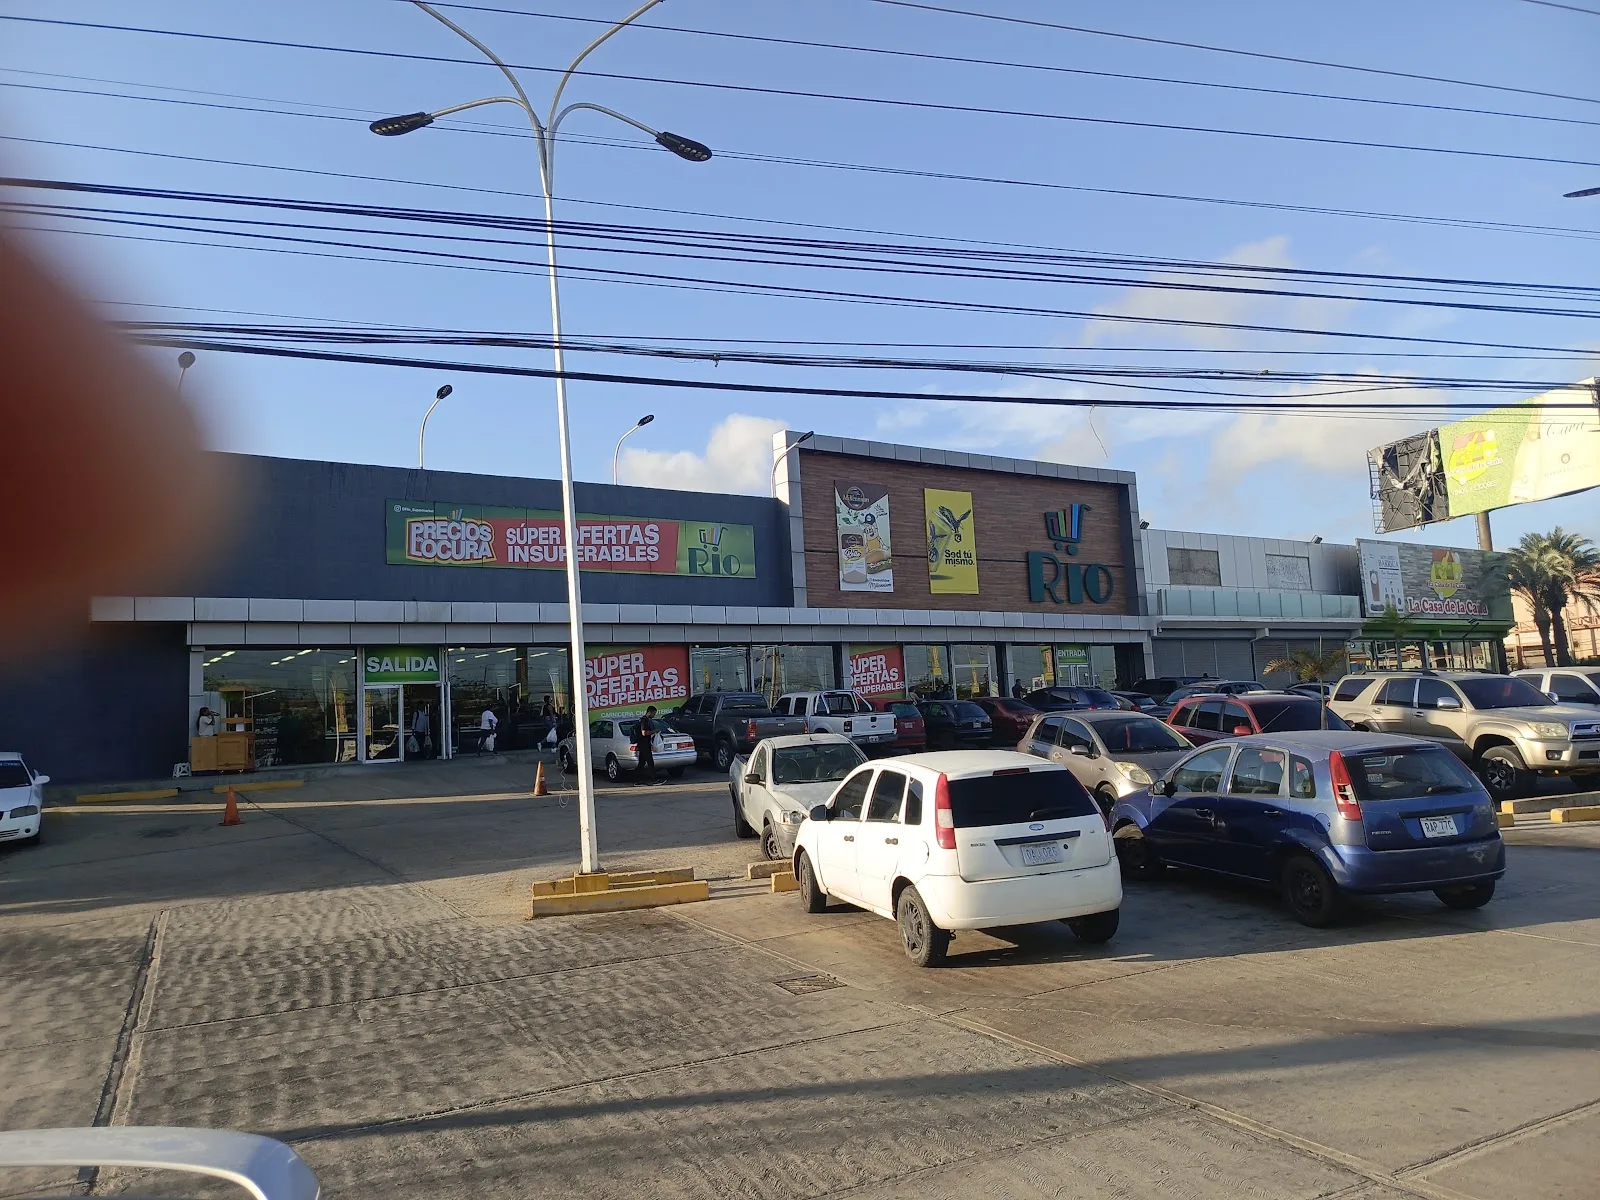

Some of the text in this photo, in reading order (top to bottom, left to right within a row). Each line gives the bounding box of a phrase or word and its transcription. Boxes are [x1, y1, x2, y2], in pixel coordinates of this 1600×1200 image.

[410, 521, 492, 541] PRECIOS
[506, 522, 660, 545] SÚPER FERTAS
[410, 539, 493, 560] LOCURA
[963, 549, 973, 559] tú
[1408, 597, 1420, 612] La
[1422, 598, 1445, 613] Casa
[1445, 599, 1455, 613] de
[1456, 600, 1466, 614] la
[367, 656, 438, 673] SALIDA
[586, 653, 644, 680] SÚPER
[587, 668, 679, 697] OFERTAS
[851, 668, 898, 687] FERTAS
[1425, 821, 1437, 833] RAP
